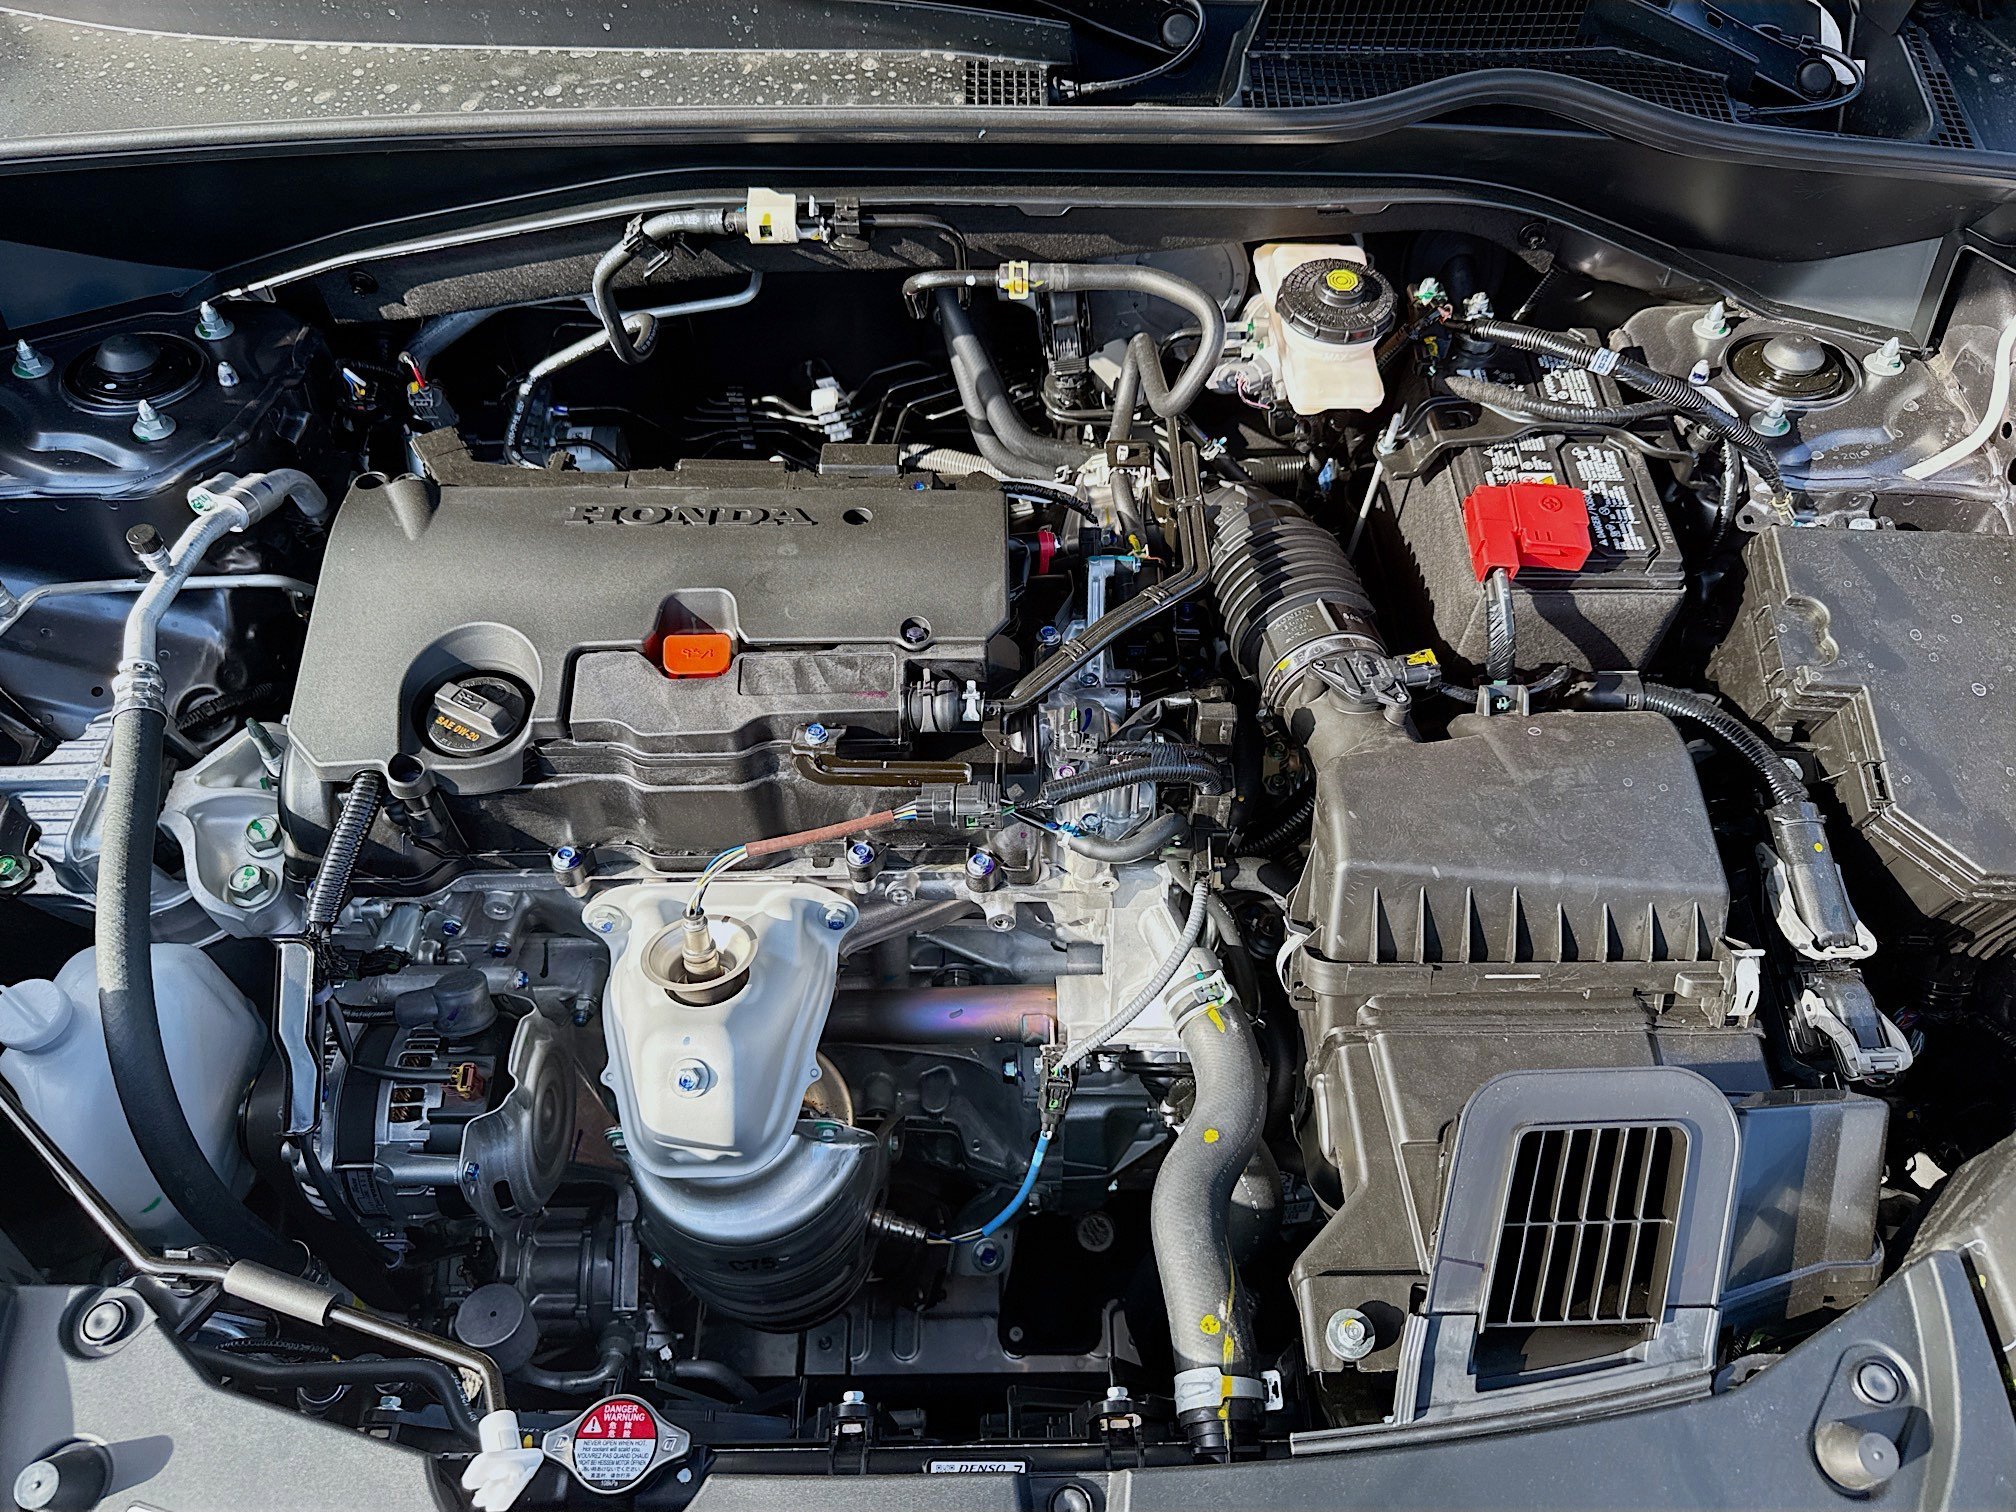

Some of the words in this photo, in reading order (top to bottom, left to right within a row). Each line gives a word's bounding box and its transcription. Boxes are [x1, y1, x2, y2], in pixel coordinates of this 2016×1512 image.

[564, 506, 819, 526] HONDA
[435, 716, 455, 731] SAE
[454, 725, 480, 742] 0W-20
[604, 1405, 639, 1413] DANGER
[603, 1413, 646, 1422] WARNUNG
[960, 1464, 1006, 1473] DENSO
